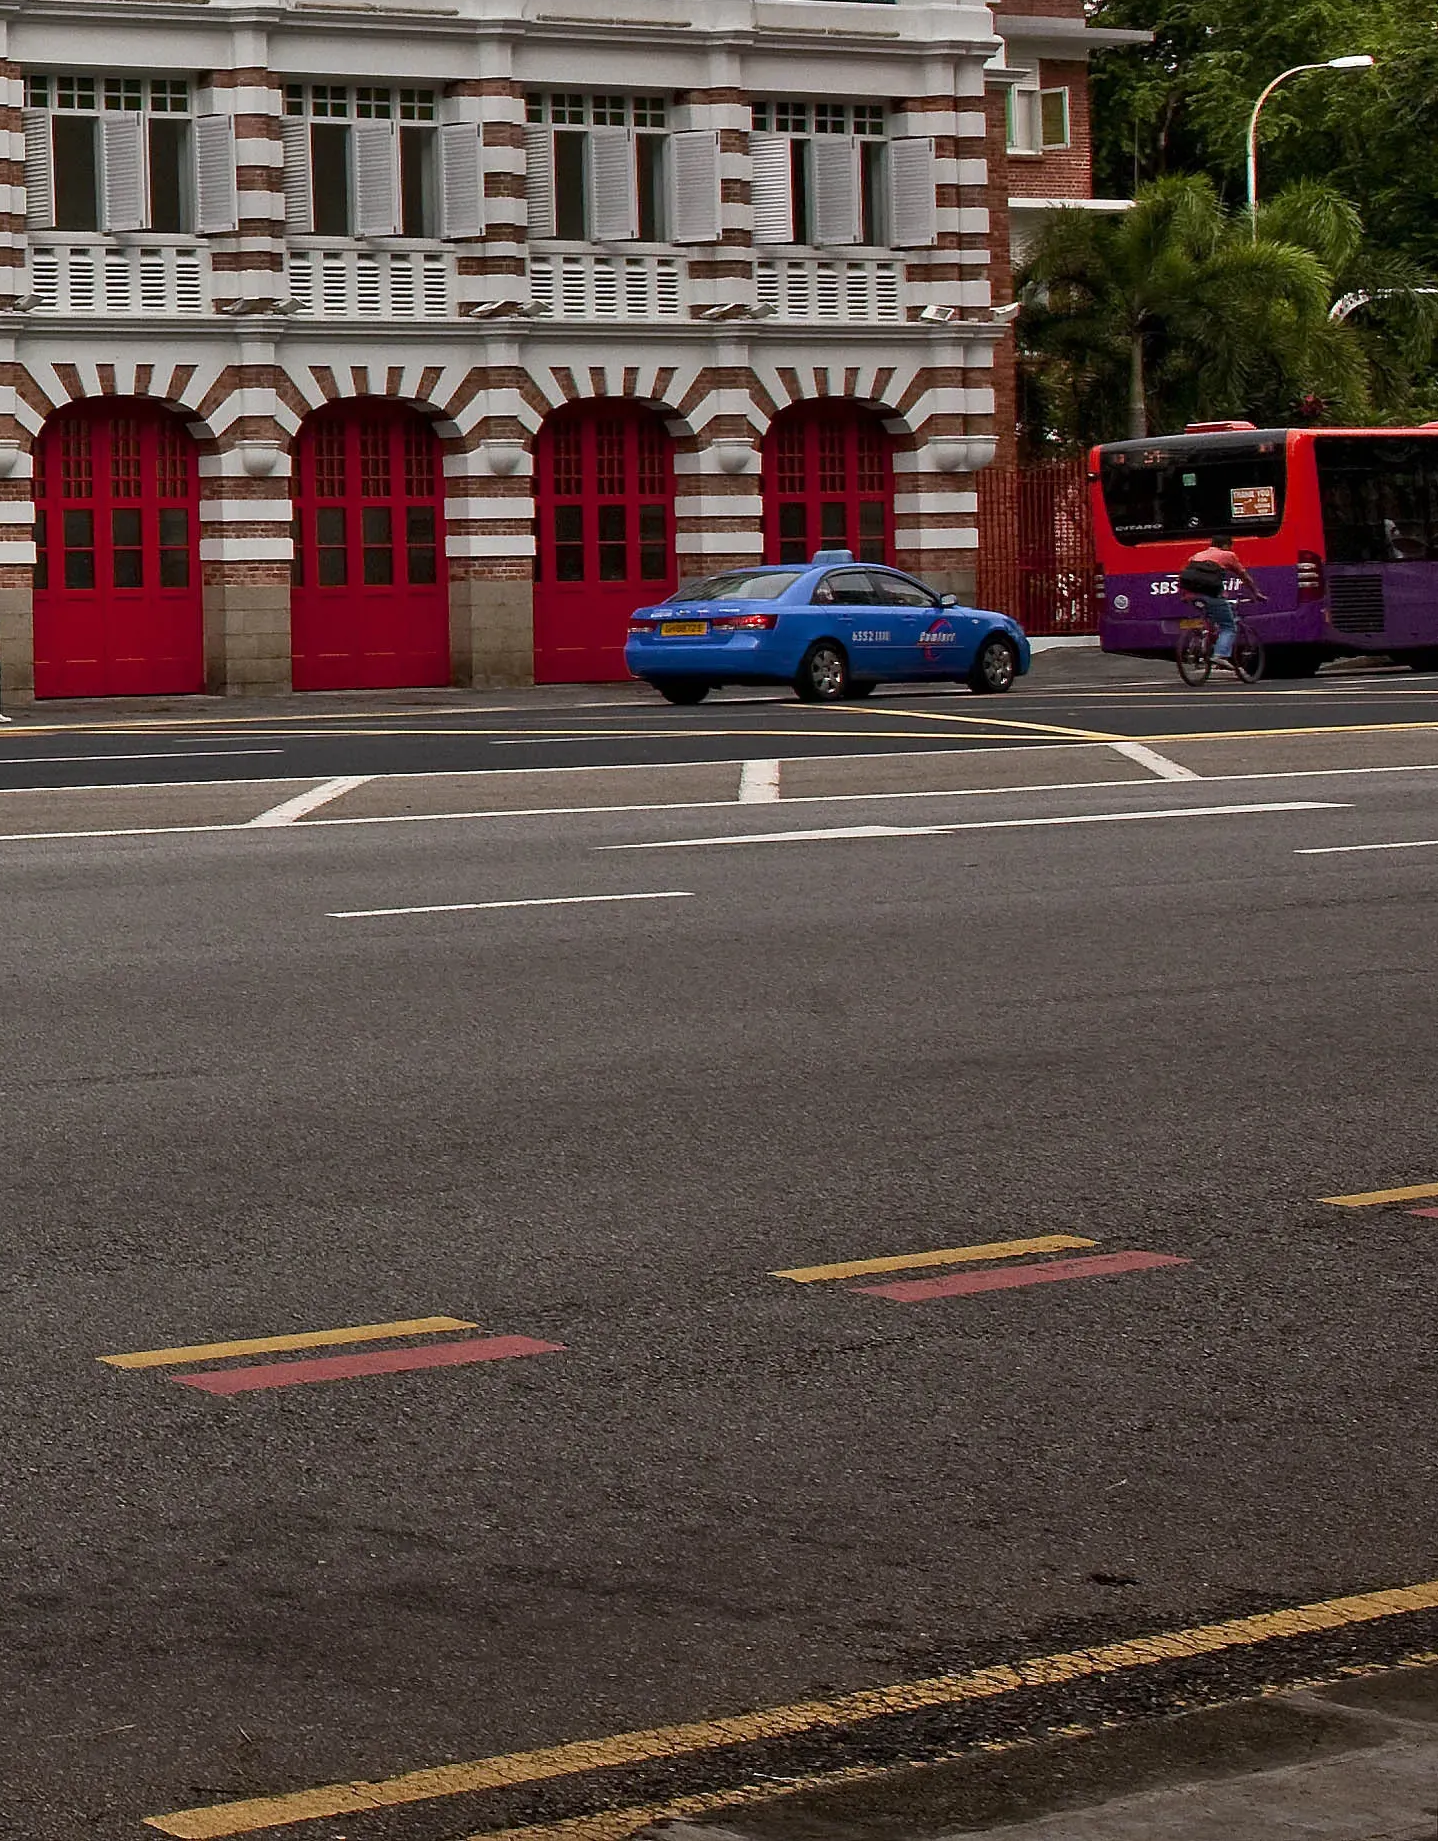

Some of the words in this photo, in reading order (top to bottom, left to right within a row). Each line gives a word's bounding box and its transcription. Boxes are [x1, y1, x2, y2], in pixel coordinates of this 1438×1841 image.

[1115, 523, 1164, 532] CITARO
[1150, 580, 1180, 596] SBS
[919, 631, 957, 643] Comfort
